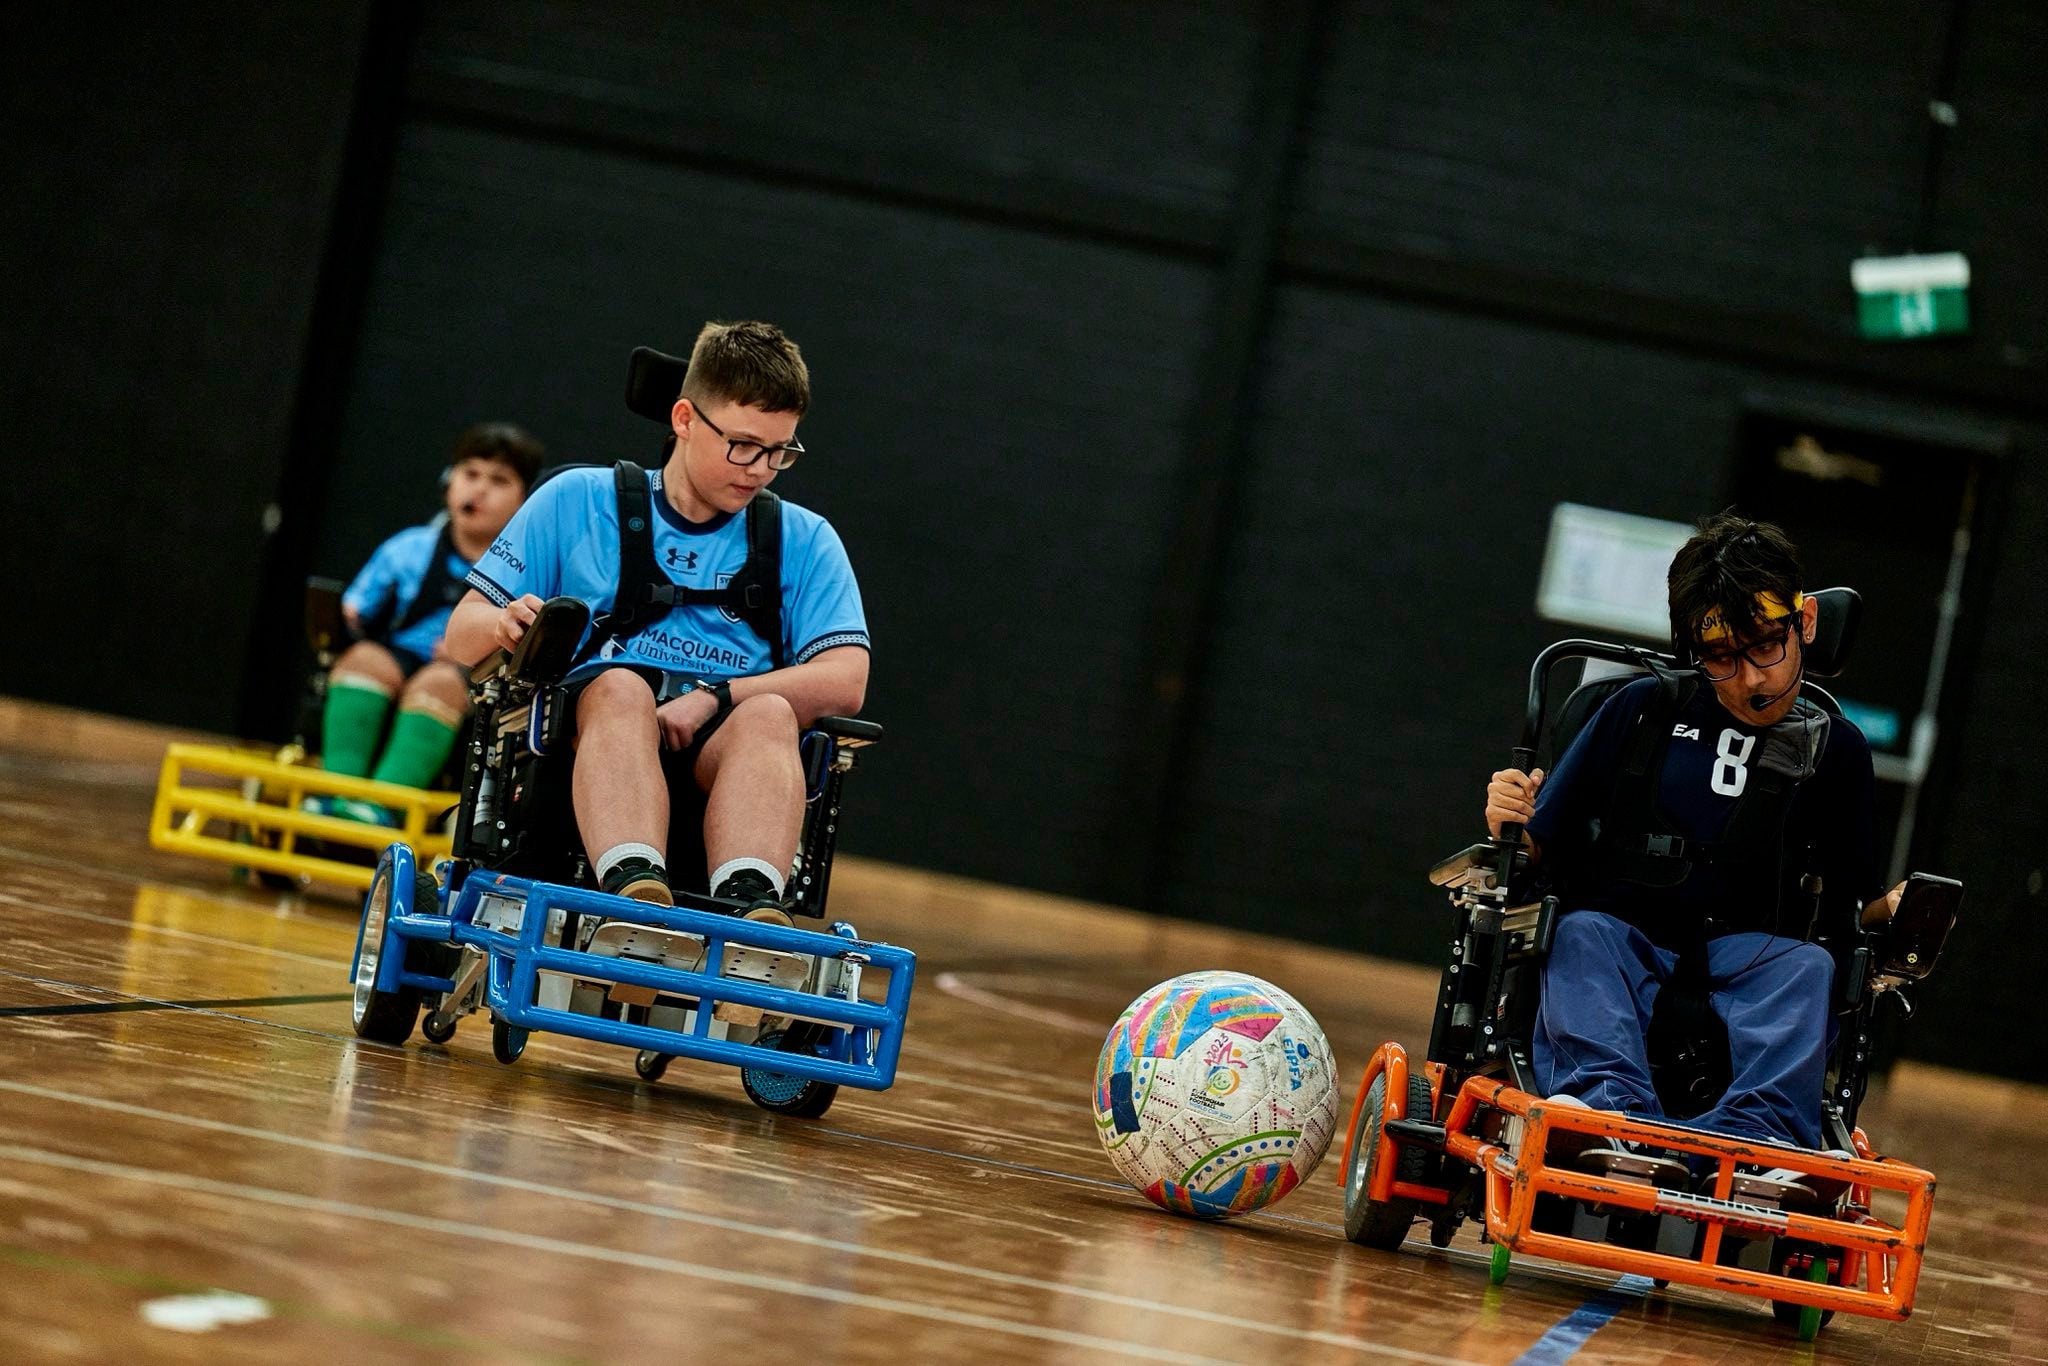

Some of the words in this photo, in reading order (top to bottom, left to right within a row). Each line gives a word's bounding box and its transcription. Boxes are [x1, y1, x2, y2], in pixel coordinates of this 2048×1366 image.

[502, 540, 513, 551] FC
[638, 641, 718, 675] University
[641, 627, 749, 671] MACQUARIE
[1671, 724, 1700, 741] EA
[1710, 727, 1756, 798] 8
[1206, 1032, 1229, 1058] 2023
